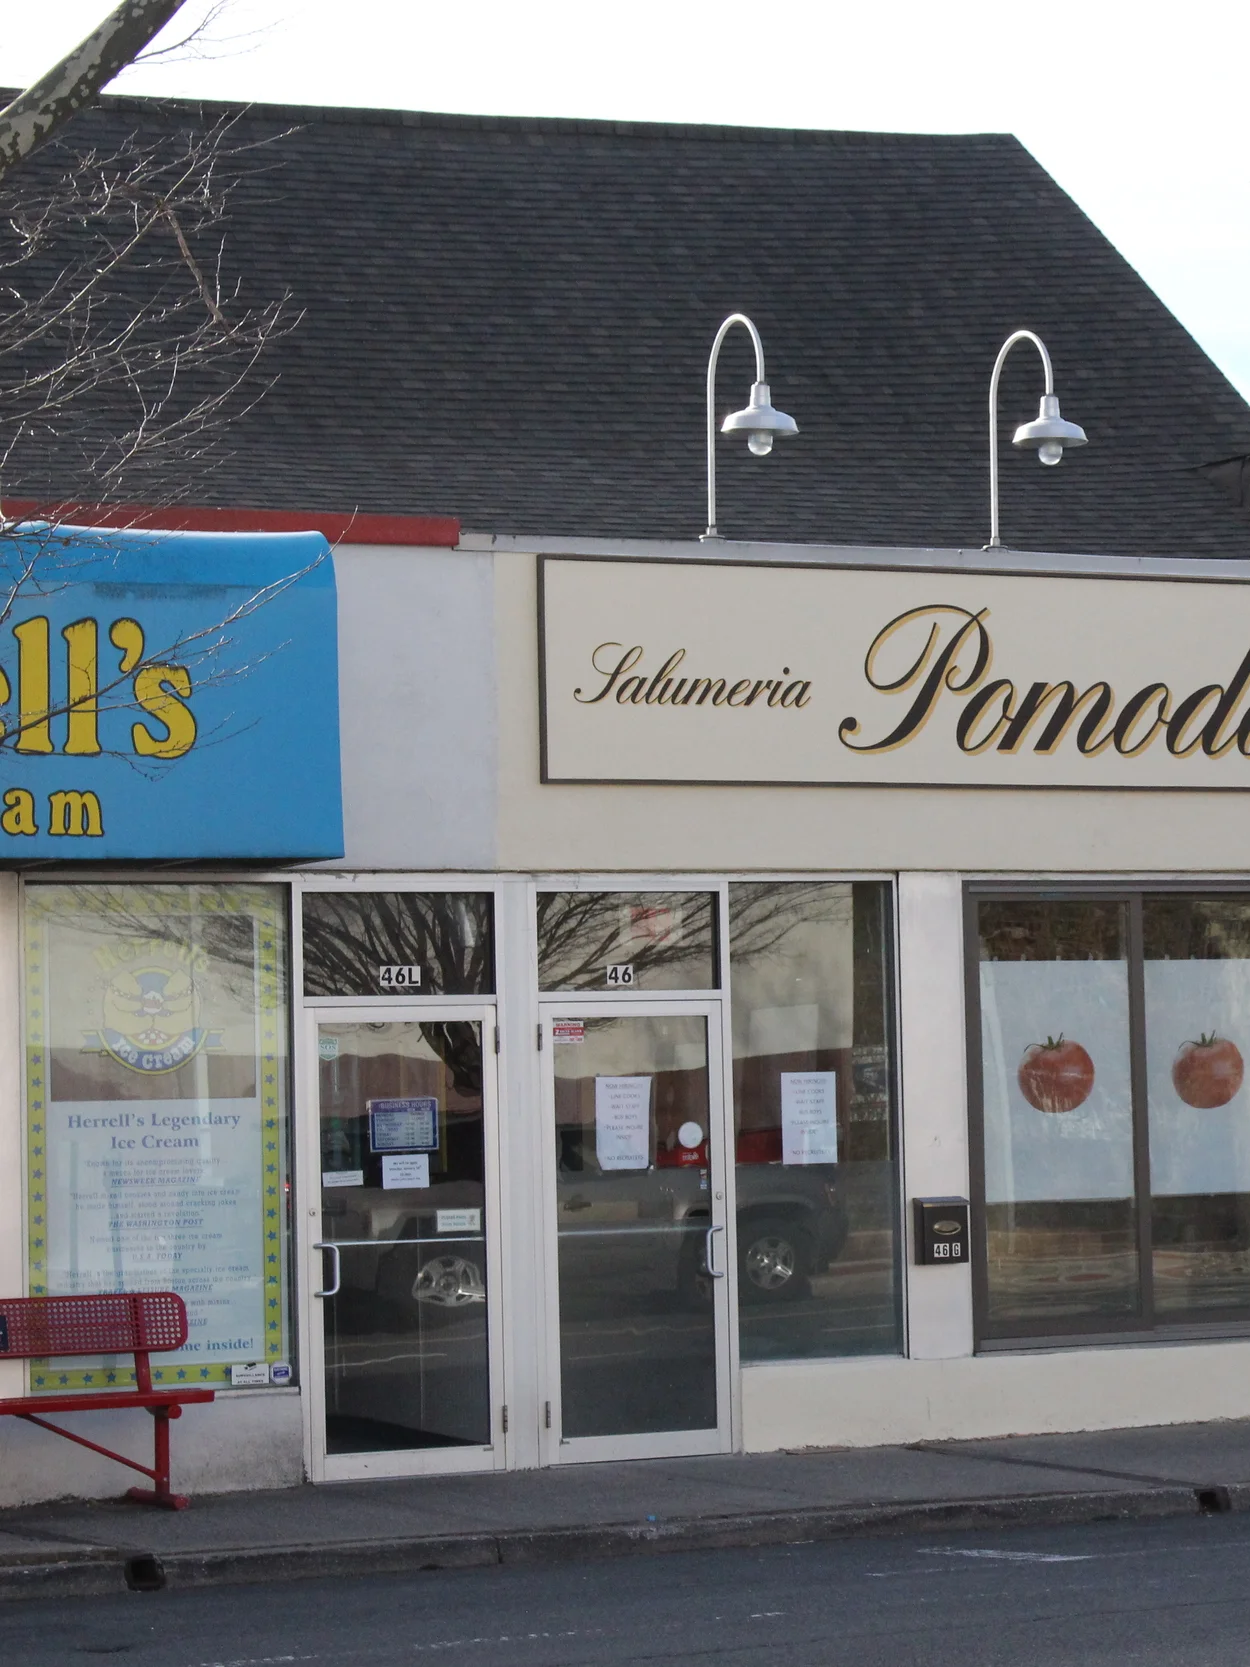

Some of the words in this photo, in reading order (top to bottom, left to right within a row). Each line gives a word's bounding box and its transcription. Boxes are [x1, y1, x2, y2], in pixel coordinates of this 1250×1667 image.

[573, 642, 812, 709] Salumeria
[0, 615, 198, 759] ll's
[380, 966, 420, 986] 46L
[608, 965, 633, 985] 46
[111, 1036, 139, 1064] Ice
[141, 1035, 196, 1070] Cream
[67, 1112, 146, 1129] Herrell's
[151, 1111, 242, 1132] Legendary
[110, 1135, 136, 1150] Ice
[141, 1134, 200, 1149] Cream
[111, 1178, 156, 1186] NEWSWEEK
[126, 1219, 181, 1228] WASHINGTON
[934, 1244, 949, 1256] 46
[171, 1284, 213, 1292] MAGAZINE
[207, 1336, 254, 1351] inside!
